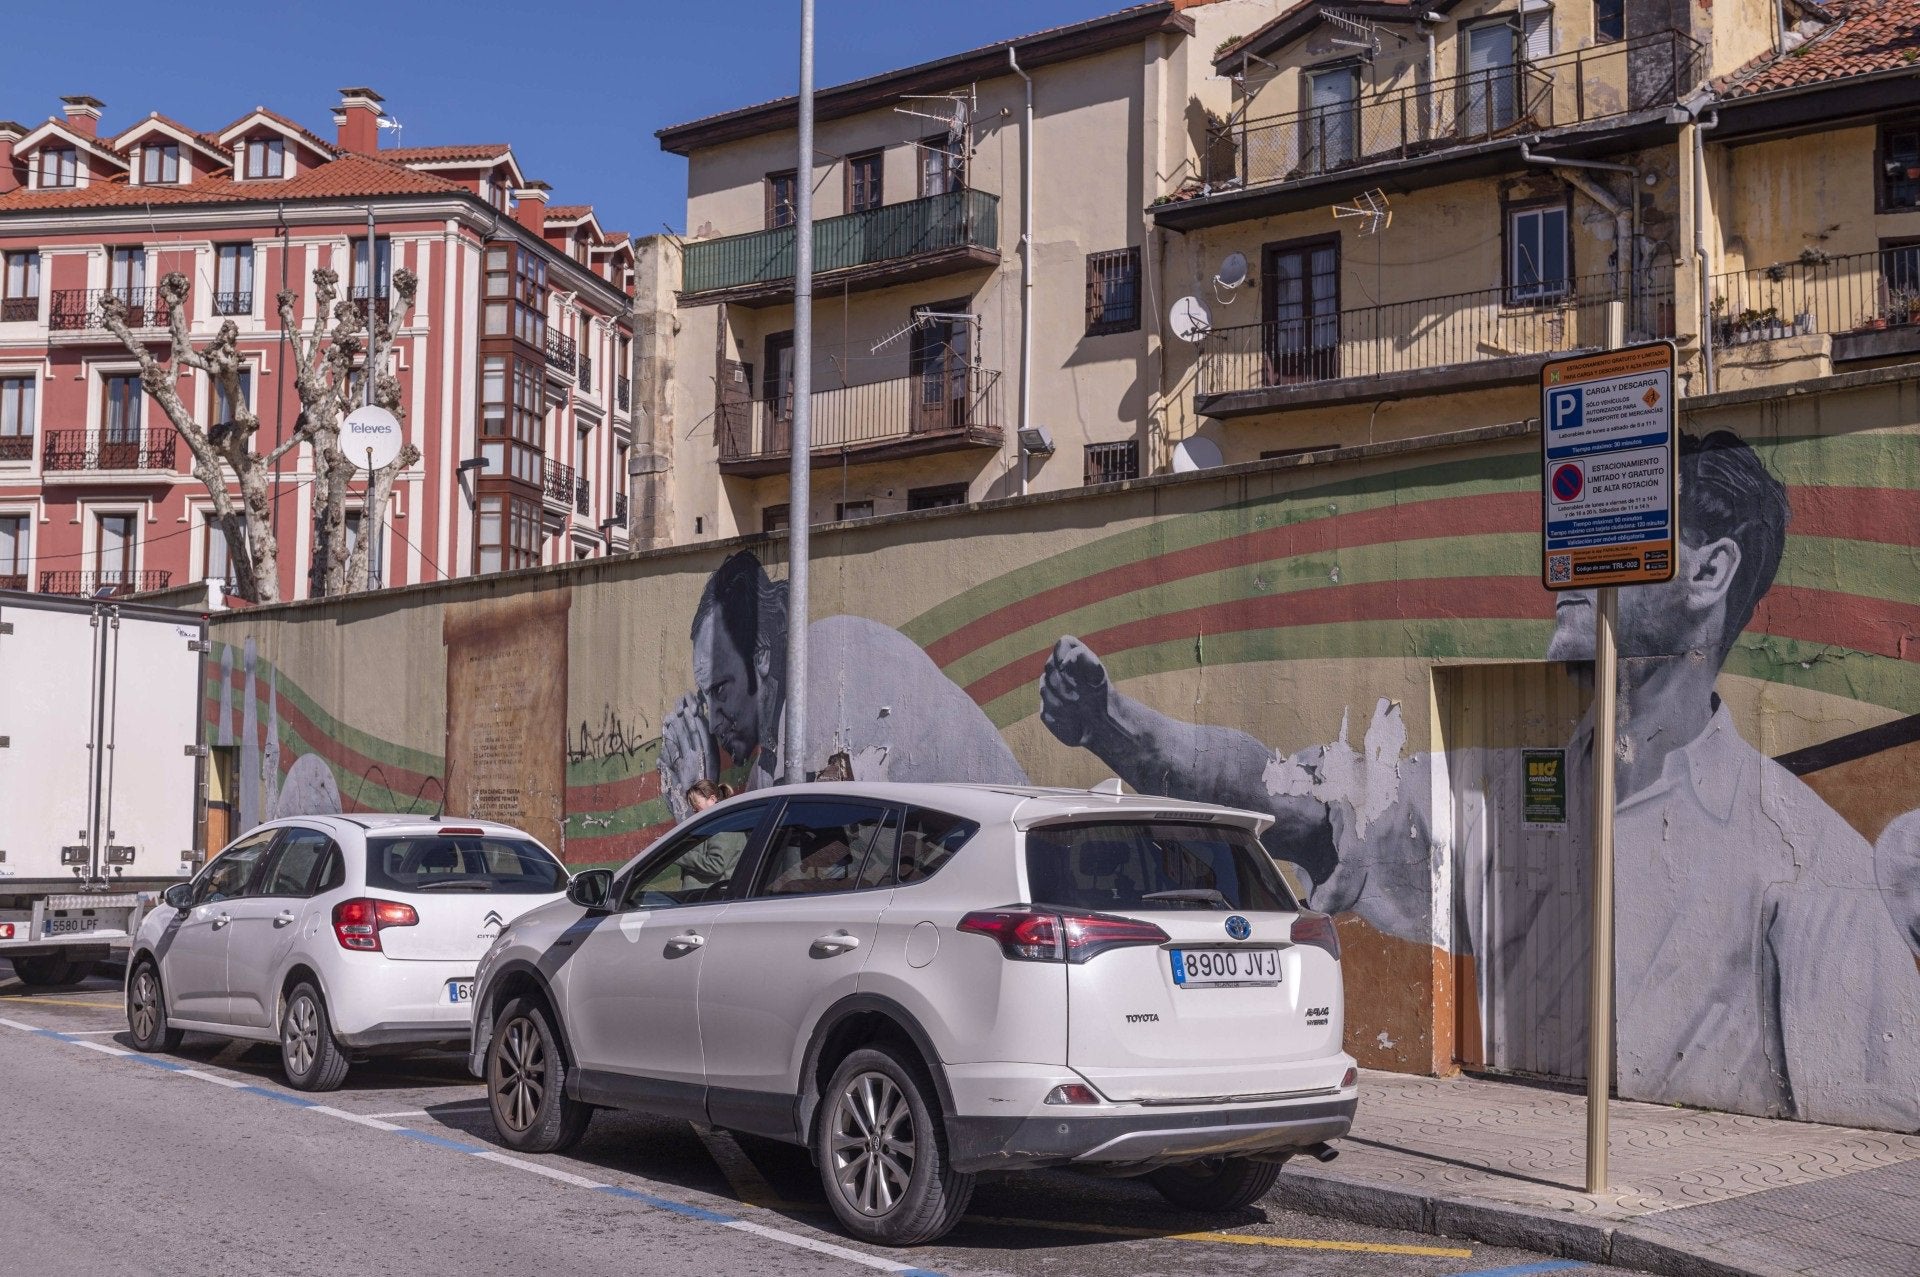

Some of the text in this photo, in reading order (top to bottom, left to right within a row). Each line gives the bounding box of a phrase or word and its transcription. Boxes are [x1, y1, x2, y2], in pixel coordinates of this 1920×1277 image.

[1567, 360, 1610, 371] ESTACIONAMIENTO
[1612, 355, 1635, 364] GRATUITO
[1642, 351, 1664, 359] LIMITADO
[1599, 366, 1624, 375] DESCARGA
[1643, 359, 1668, 367] ROTACIÓN
[1586, 386, 1610, 396] CARGA
[1619, 379, 1658, 391] DESCARGA
[1601, 397, 1630, 405] VEHÍCULOS
[1556, 393, 1576, 427] P
[1586, 406, 1622, 415] AUTORIZADOS
[1586, 414, 1619, 423] TRANSPORTE
[1629, 408, 1663, 417] MERCANCÍAS
[349, 423, 392, 433] Televes
[1592, 458, 1659, 472] ESTACIONAMIENTO
[1587, 474, 1620, 483] LIMITADO
[1628, 468, 1664, 478] GRATUITO
[1604, 484, 1620, 492] ALTA
[1622, 479, 1659, 490] ROTACIÓN
[53, 919, 98, 931] 5580 LPF
[1186, 953, 1276, 976] 8900 JVJ
[1126, 1014, 1159, 1023] TOYOTA
